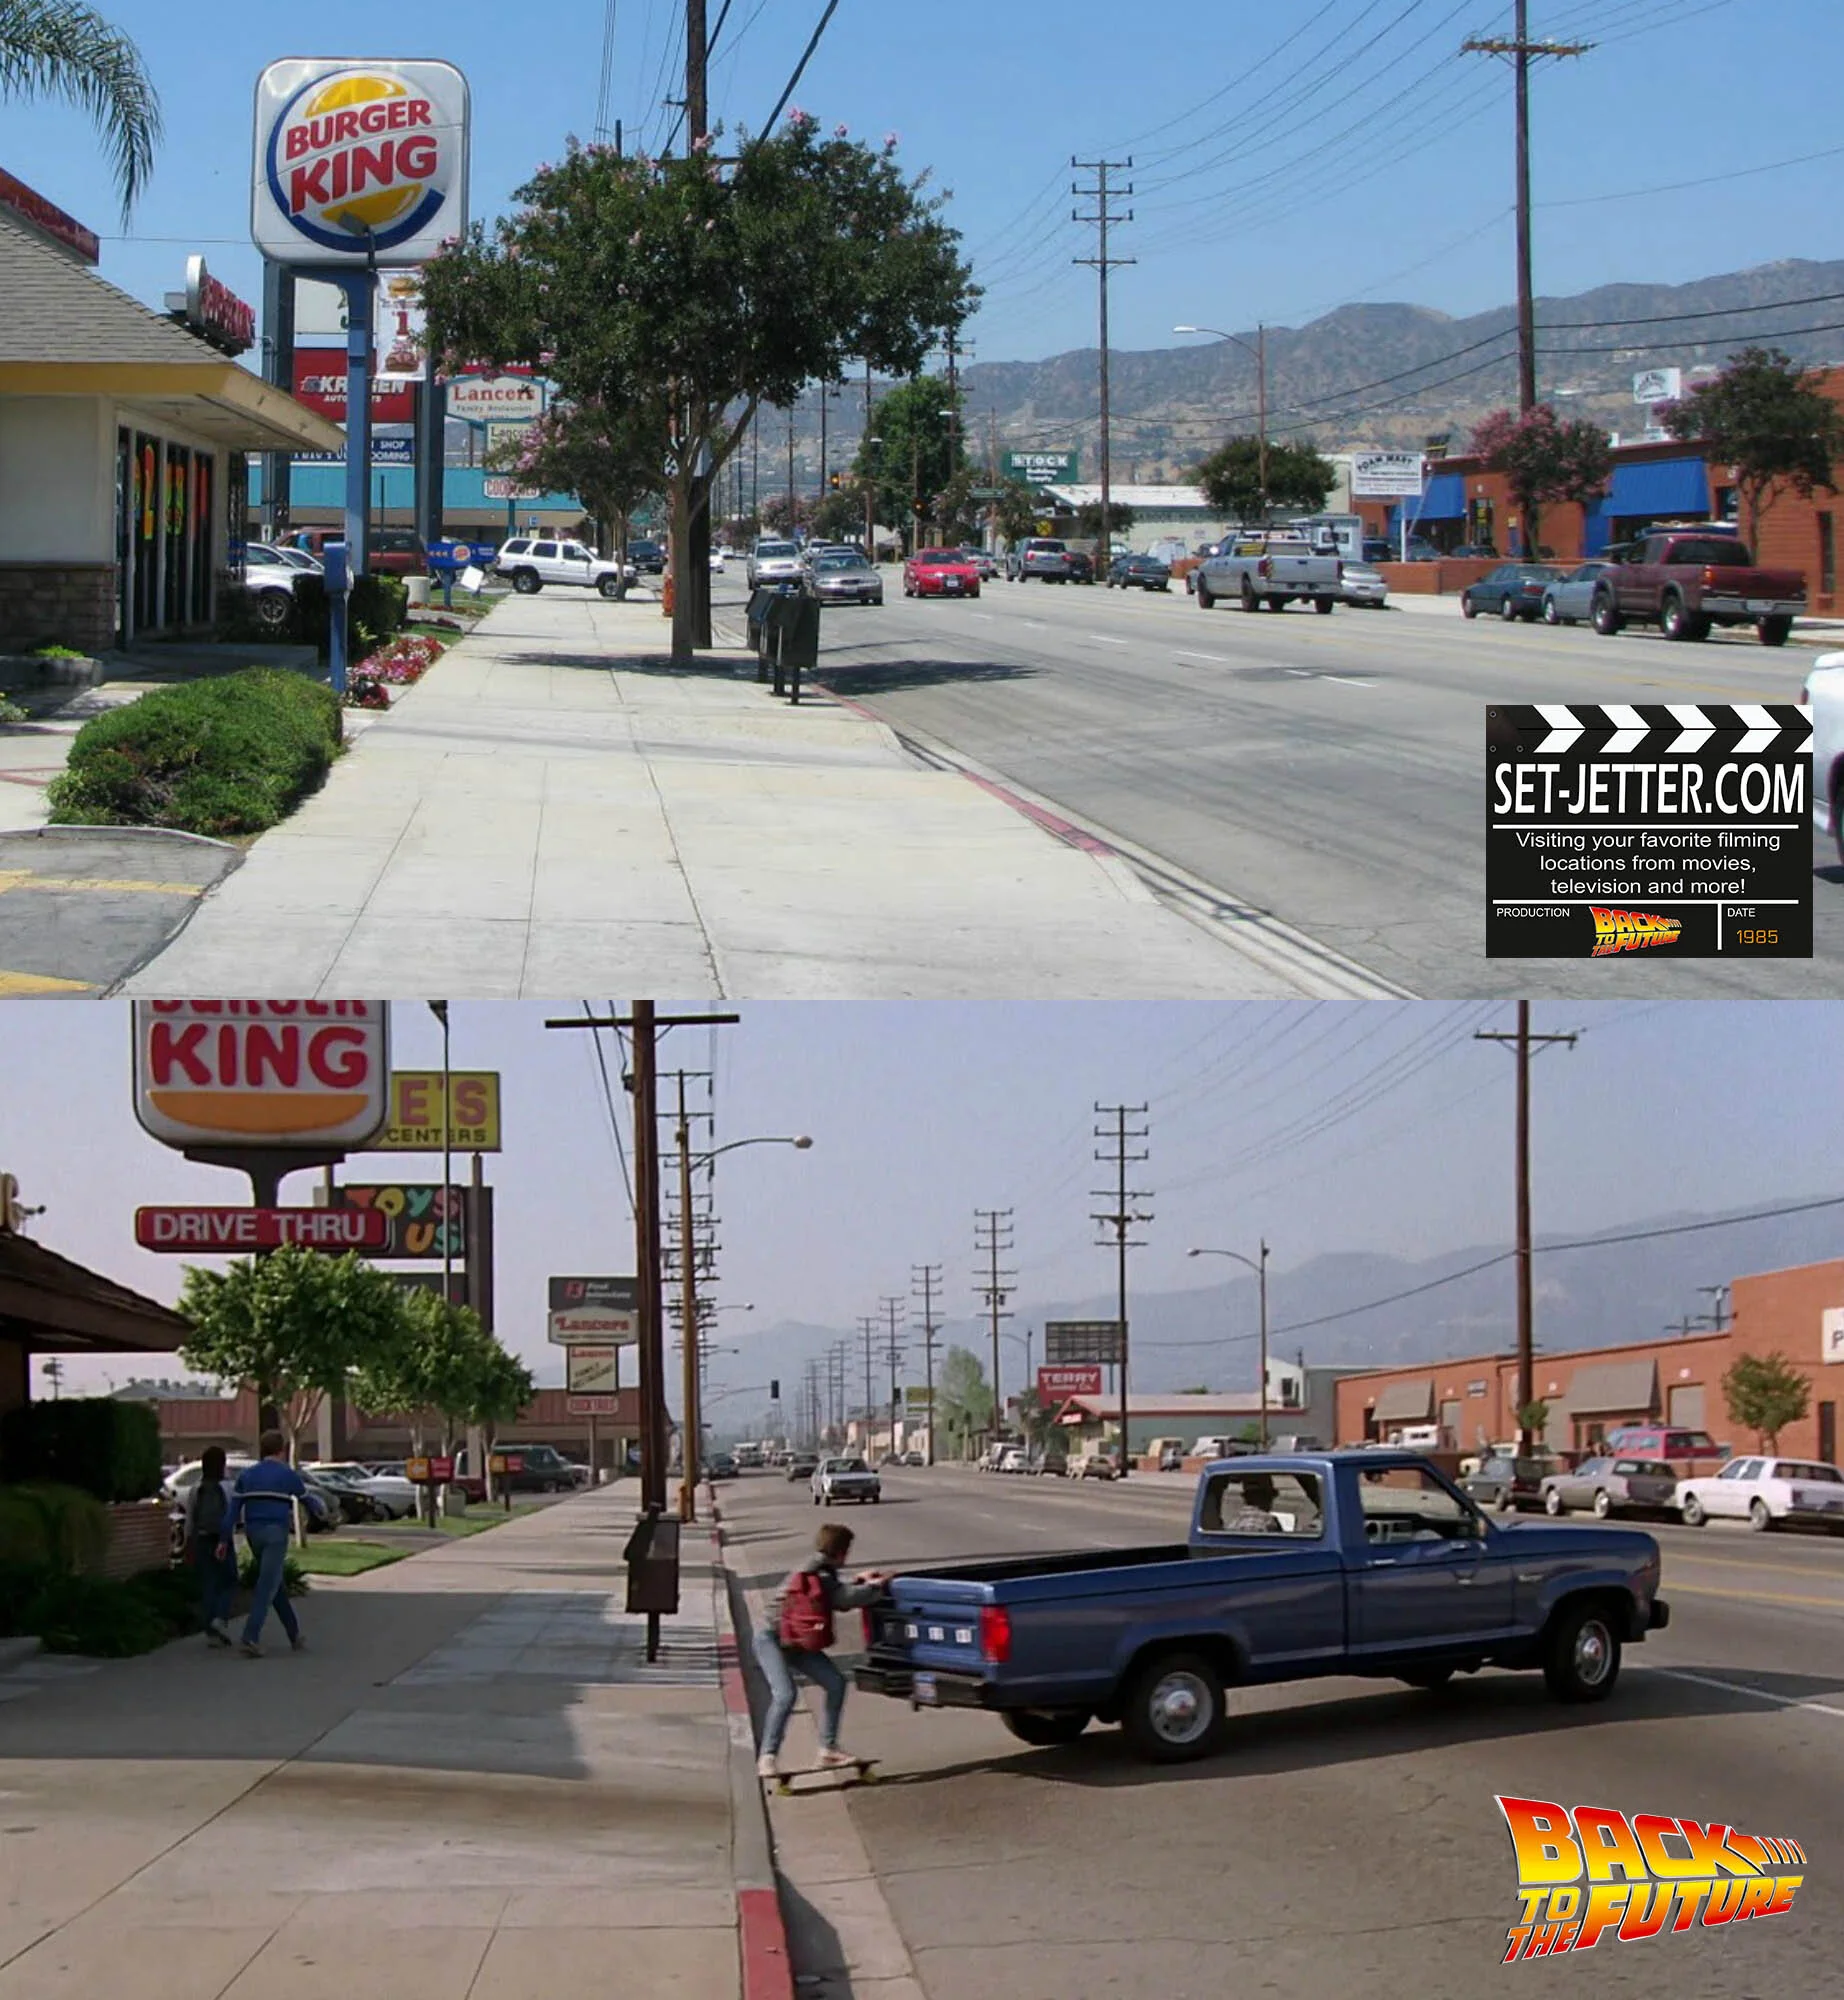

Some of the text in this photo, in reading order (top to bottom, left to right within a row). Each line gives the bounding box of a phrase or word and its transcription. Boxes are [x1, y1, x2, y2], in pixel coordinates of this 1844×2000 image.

[285, 100, 432, 161] BURGER
[290, 134, 438, 214] KING
[380, 441, 406, 450] SHOP
[1011, 453, 1069, 467] STOCK
[150, 1022, 369, 1088] KING
[153, 1214, 366, 1243] DRIVE THRU
[405, 1222, 461, 1254] US
[1041, 1372, 1098, 1383] TERRY
